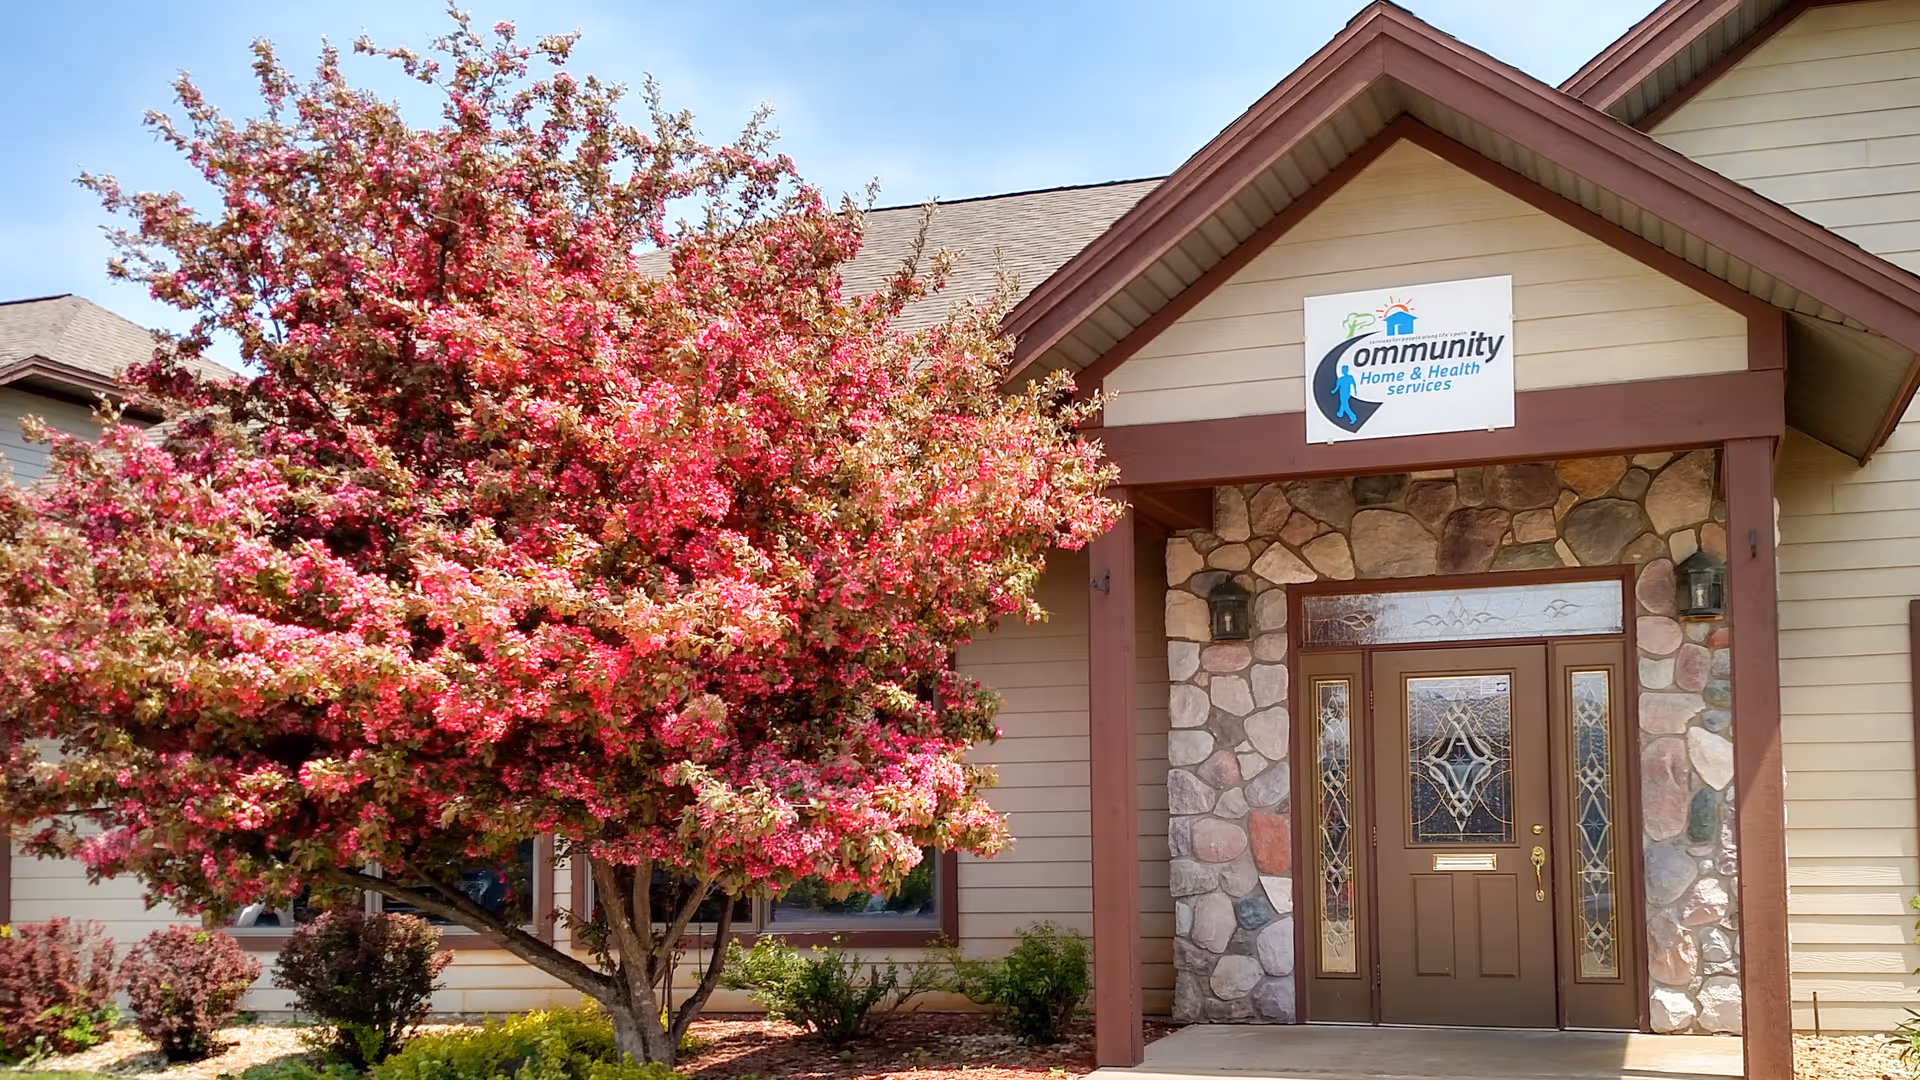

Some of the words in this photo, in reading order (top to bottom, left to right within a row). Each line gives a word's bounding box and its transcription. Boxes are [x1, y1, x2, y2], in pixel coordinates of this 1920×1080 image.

[1360, 371, 1405, 385] Home
[1410, 366, 1422, 381] &
[1428, 361, 1480, 379] Health
[1387, 379, 1451, 396] services
